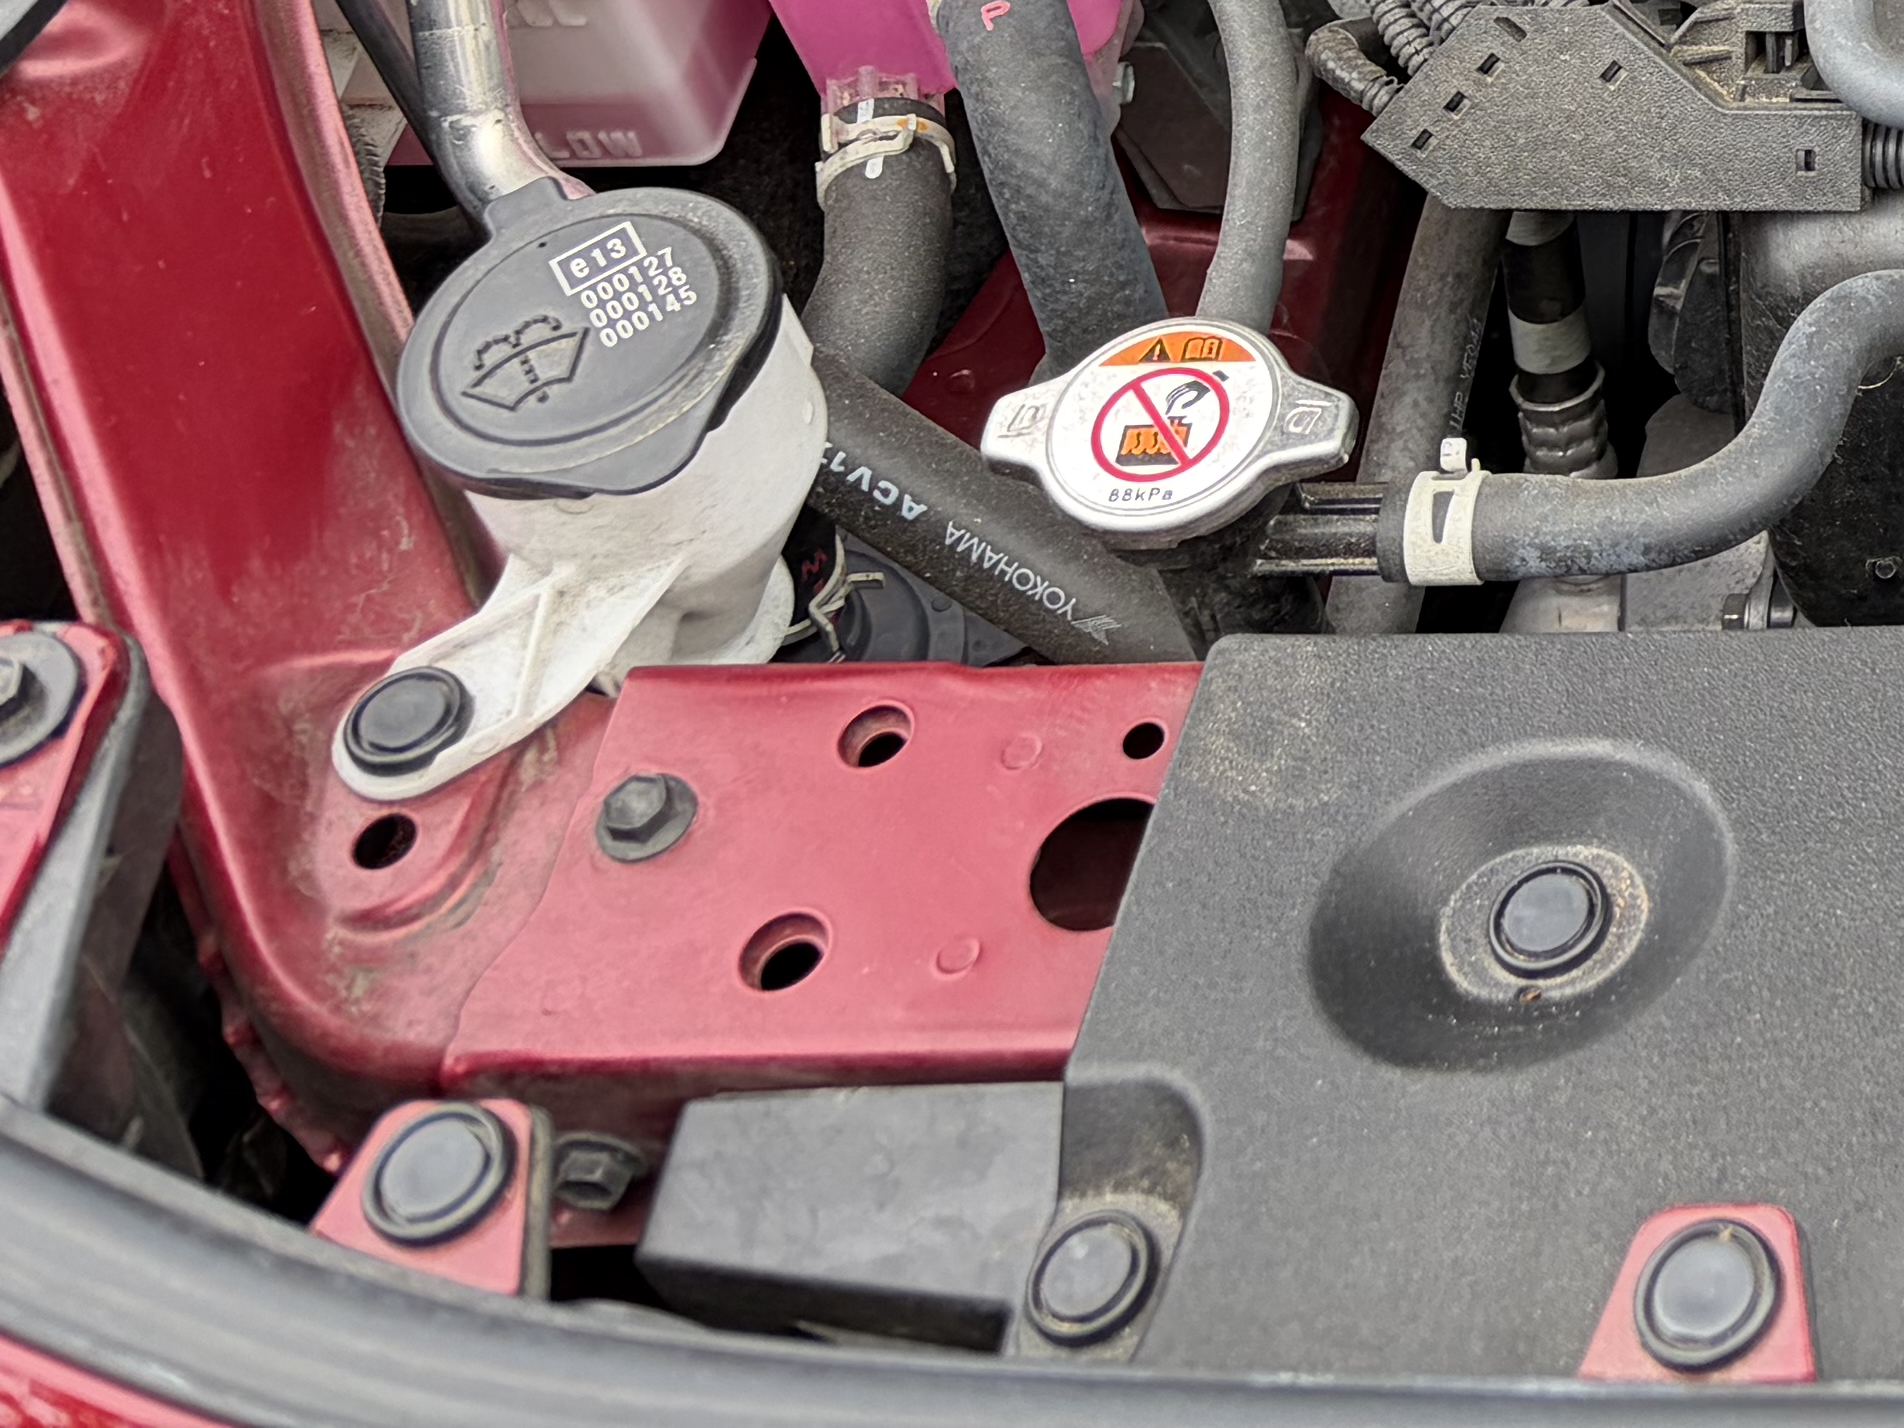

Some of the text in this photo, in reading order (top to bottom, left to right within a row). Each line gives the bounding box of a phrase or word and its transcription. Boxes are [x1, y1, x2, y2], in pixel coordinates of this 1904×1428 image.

[980, 0, 1011, 32] P
[534, 130, 643, 158] LOW
[569, 237, 627, 279] e13
[580, 246, 674, 310] 000127
[589, 266, 688, 329] 000128
[599, 285, 698, 348] 000145
[1108, 487, 1174, 503] 88kPa
[944, 519, 1078, 622] YOKOHAMA
